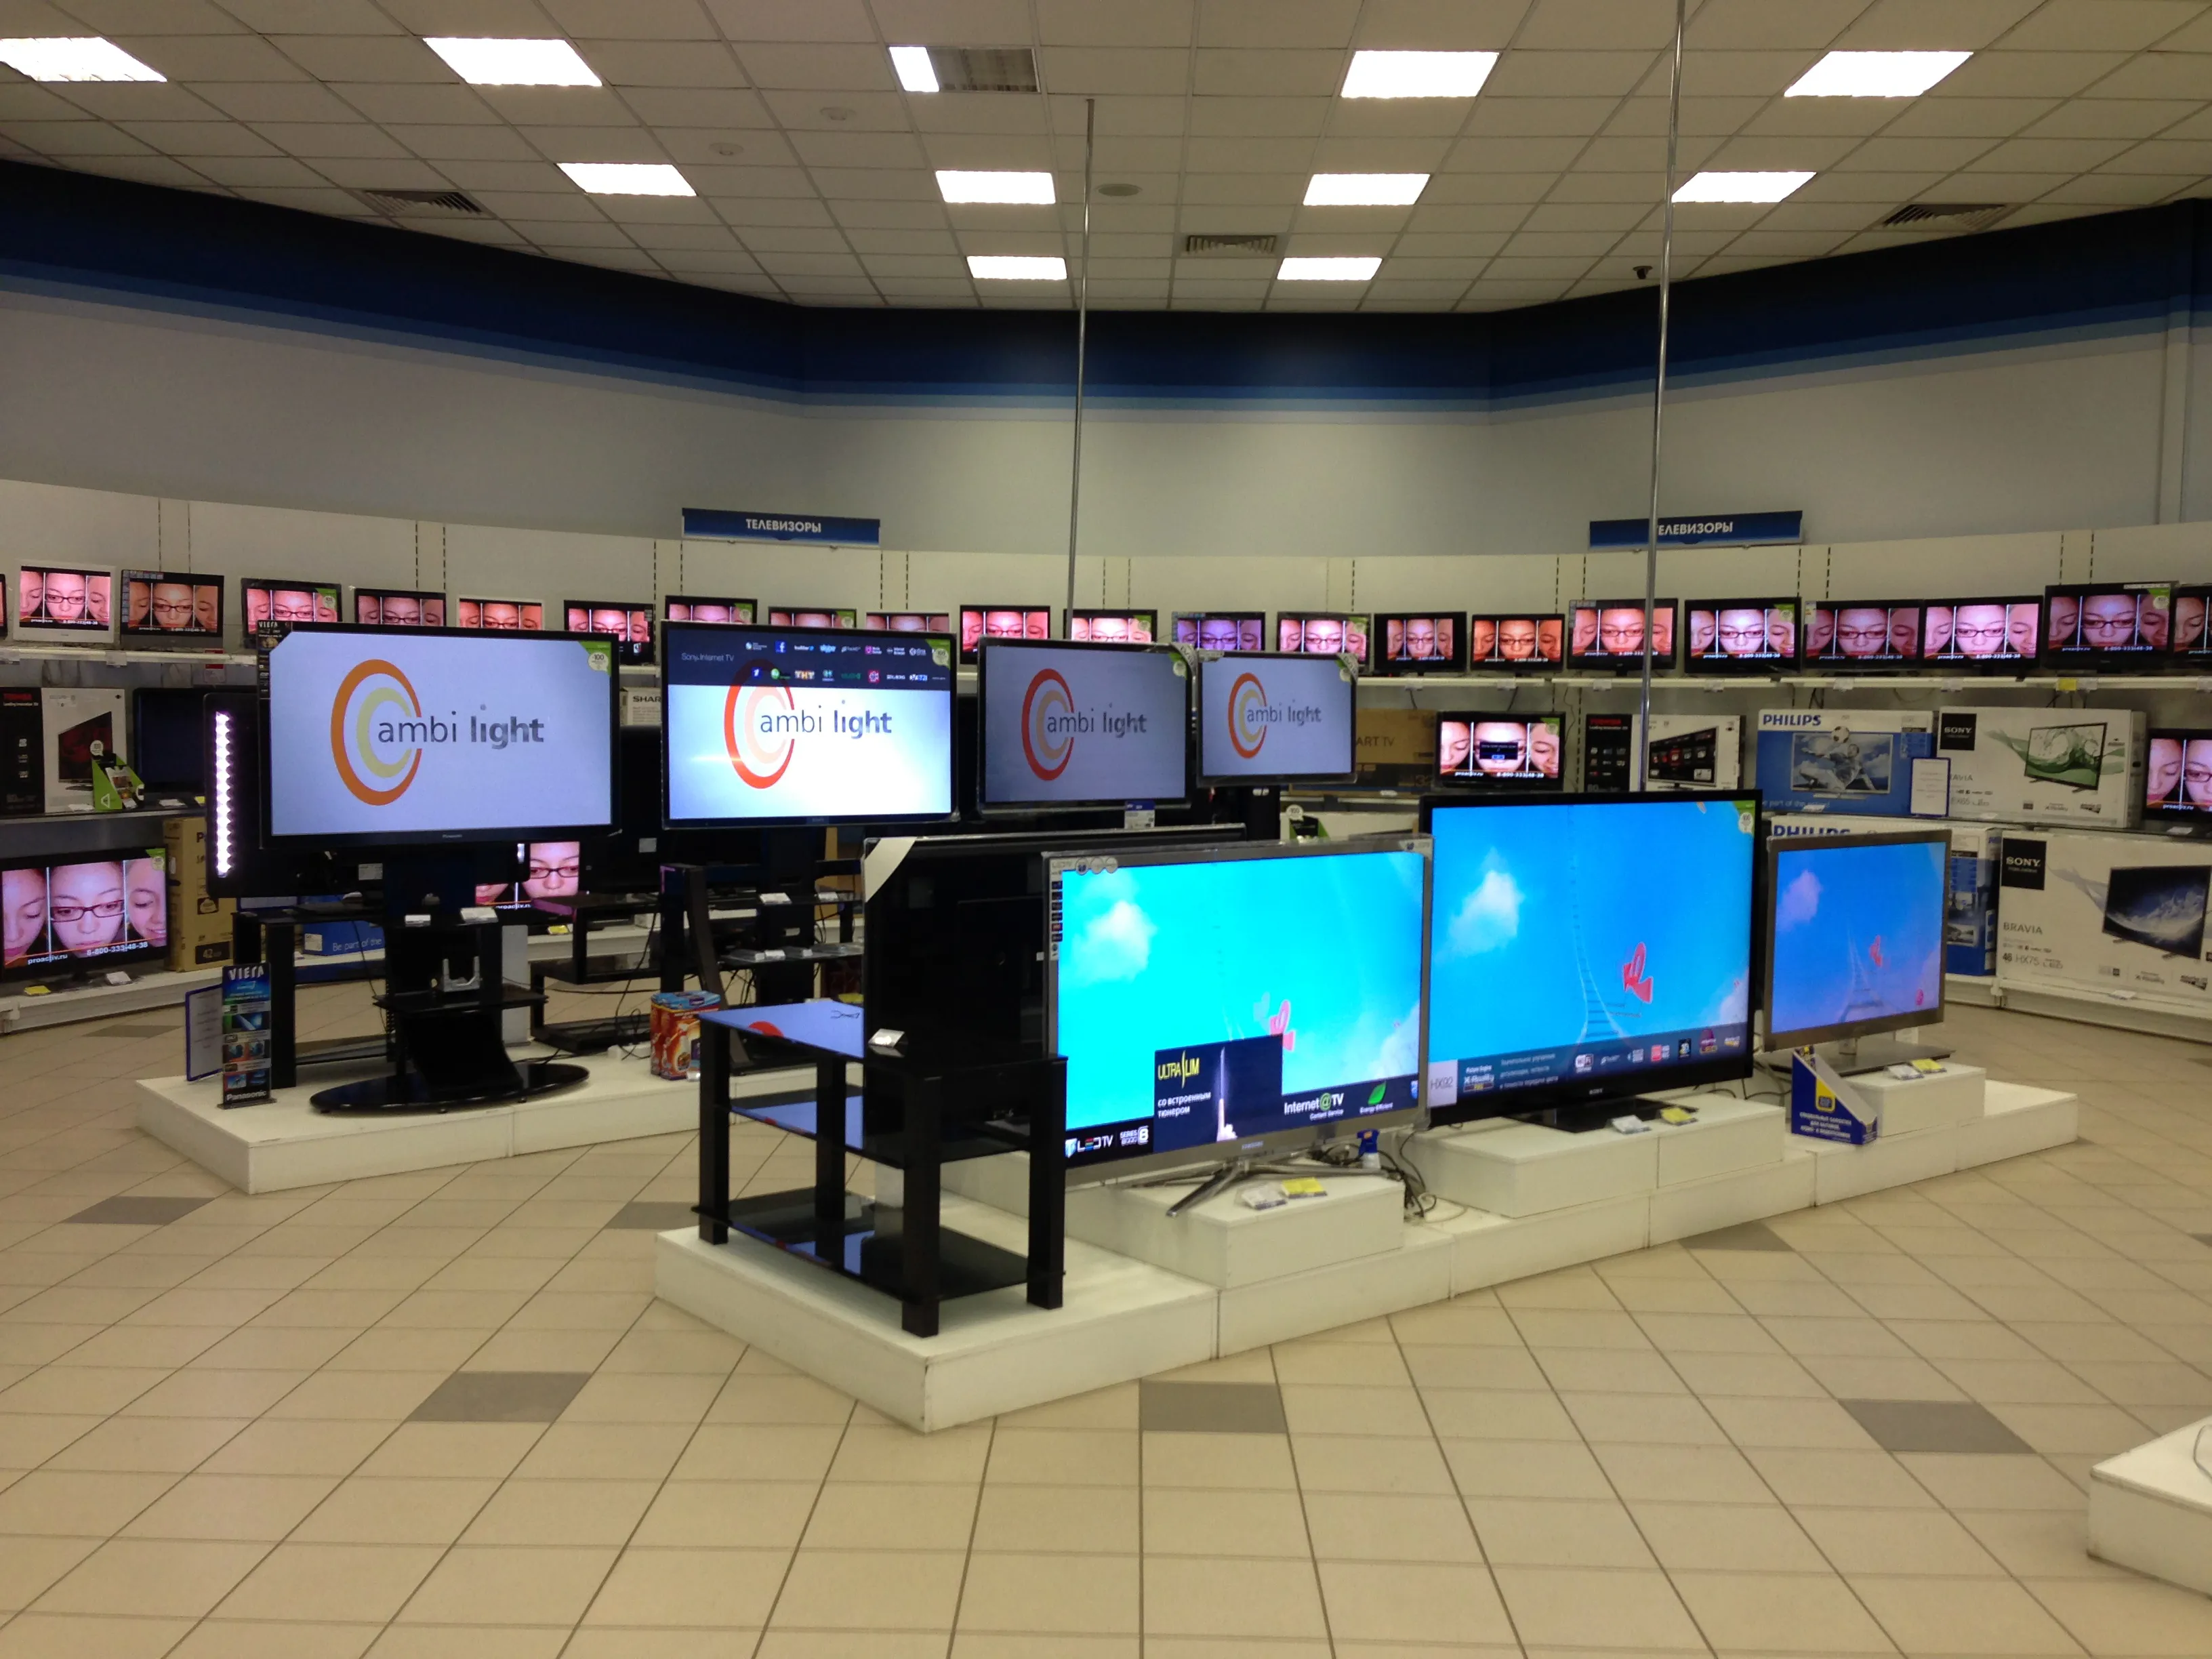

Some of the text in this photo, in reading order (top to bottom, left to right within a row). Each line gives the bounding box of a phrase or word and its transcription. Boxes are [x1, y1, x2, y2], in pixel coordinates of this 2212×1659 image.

[746, 518, 821, 533] ТЕЛЕВИЗОРЫ
[1657, 521, 1734, 536] ЕЛЕВИЗОРЫ
[760, 699, 893, 739] ambi light
[1046, 702, 1147, 738] ambi light
[1246, 699, 1322, 726] ambi light
[1763, 714, 1822, 726] PHILIPS
[378, 703, 544, 750] ambi light
[1355, 736, 1396, 746] ART TV
[2005, 856, 2041, 867] SONY
[2003, 922, 2043, 935] BRAVIA
[332, 943, 342, 951] Be
[344, 941, 359, 951] part
[1158, 1092, 1212, 1108] со встроенным
[1158, 1106, 1191, 1119] тюнером
[1101, 1134, 1114, 1149] TV
